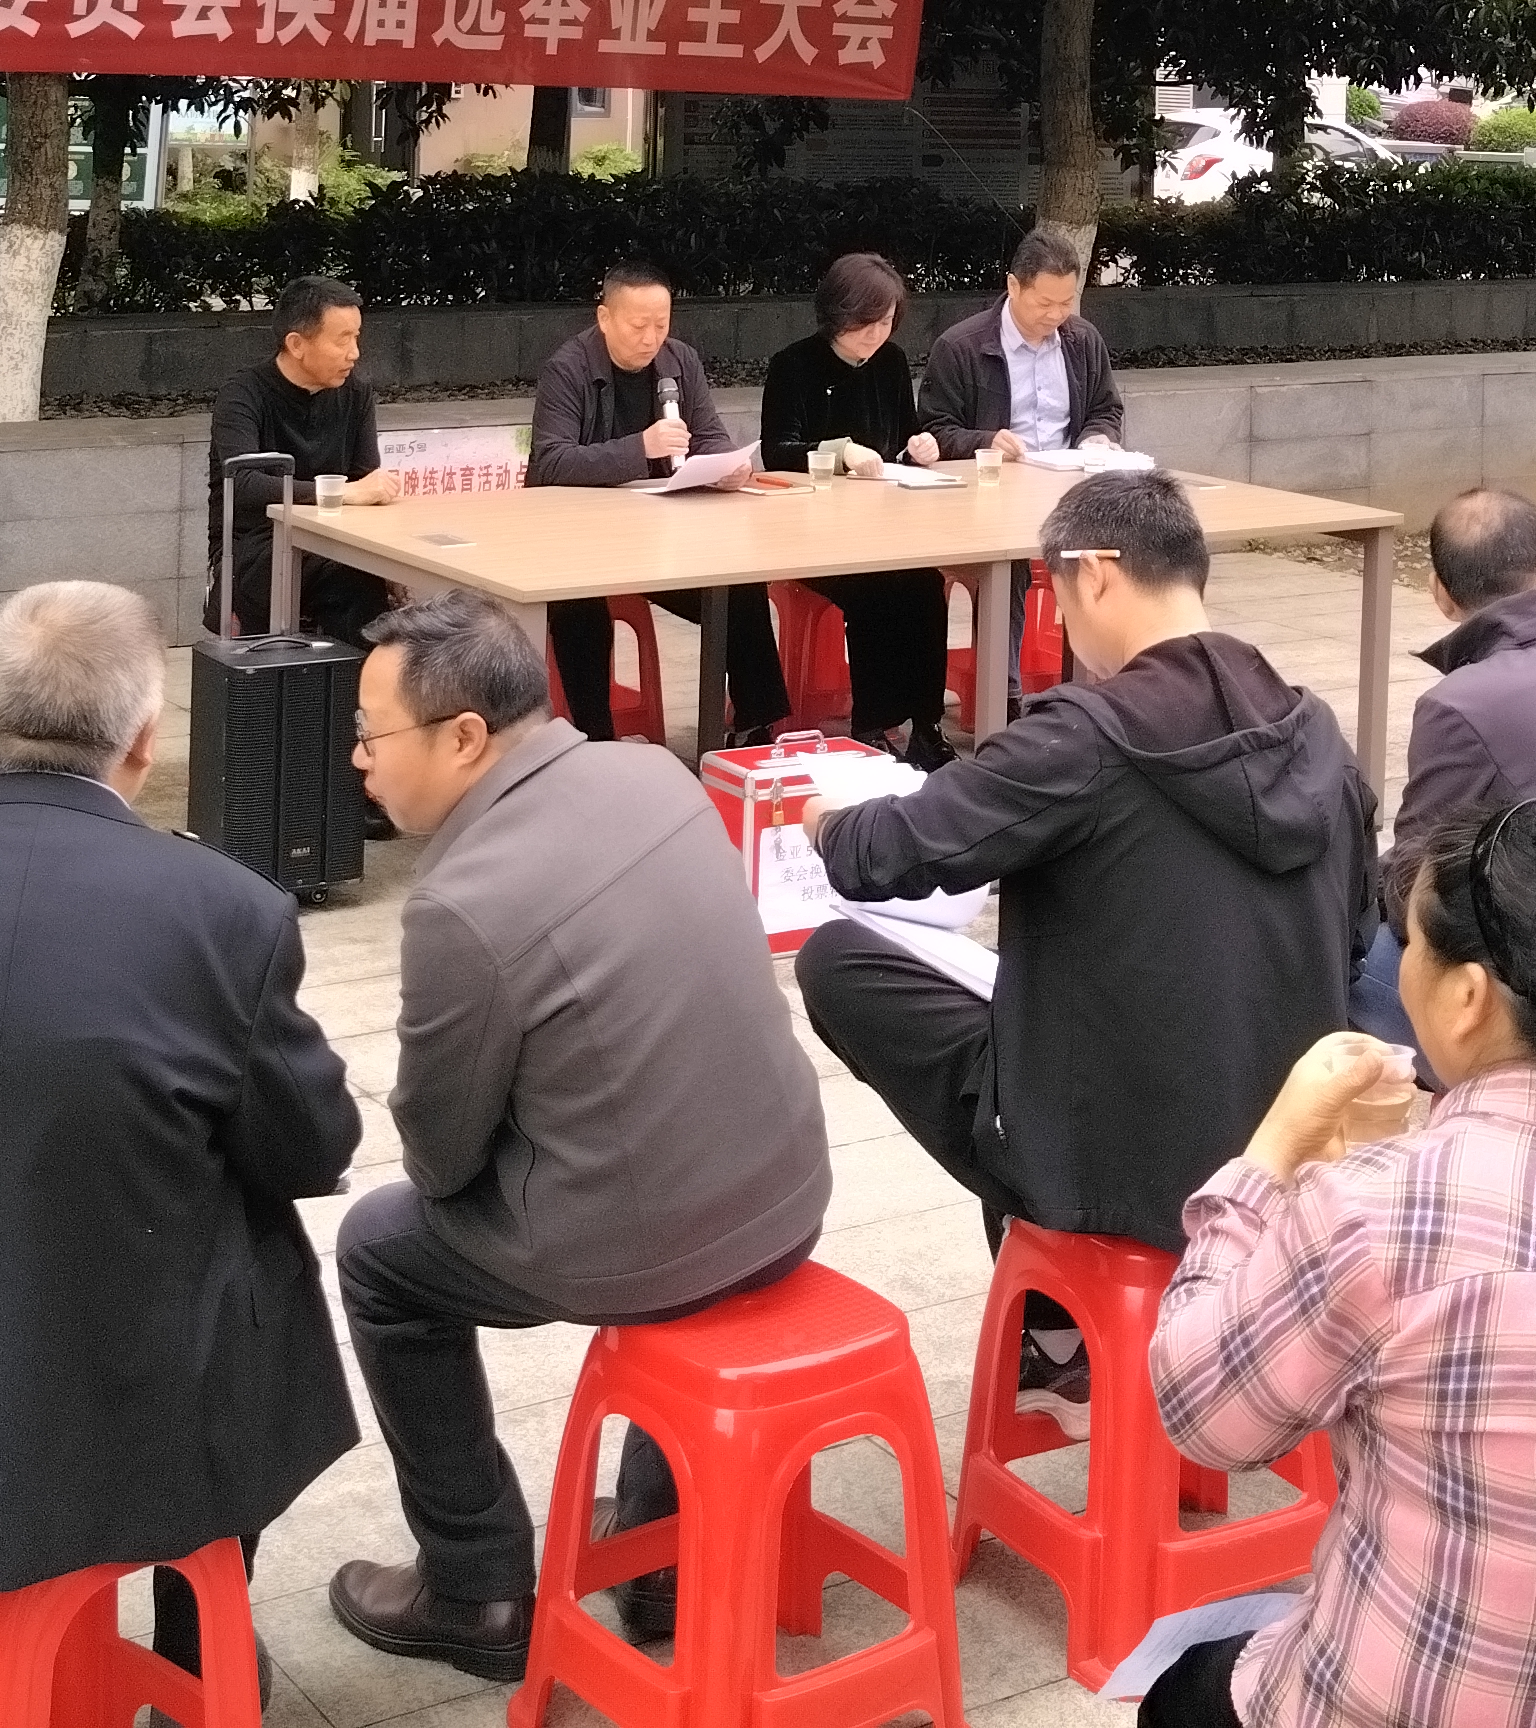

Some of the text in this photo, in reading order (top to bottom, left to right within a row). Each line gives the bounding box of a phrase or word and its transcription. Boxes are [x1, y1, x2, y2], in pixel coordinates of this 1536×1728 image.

[387, 460, 529, 497] 晚练体育活动点
[780, 863, 826, 884] 委会换
